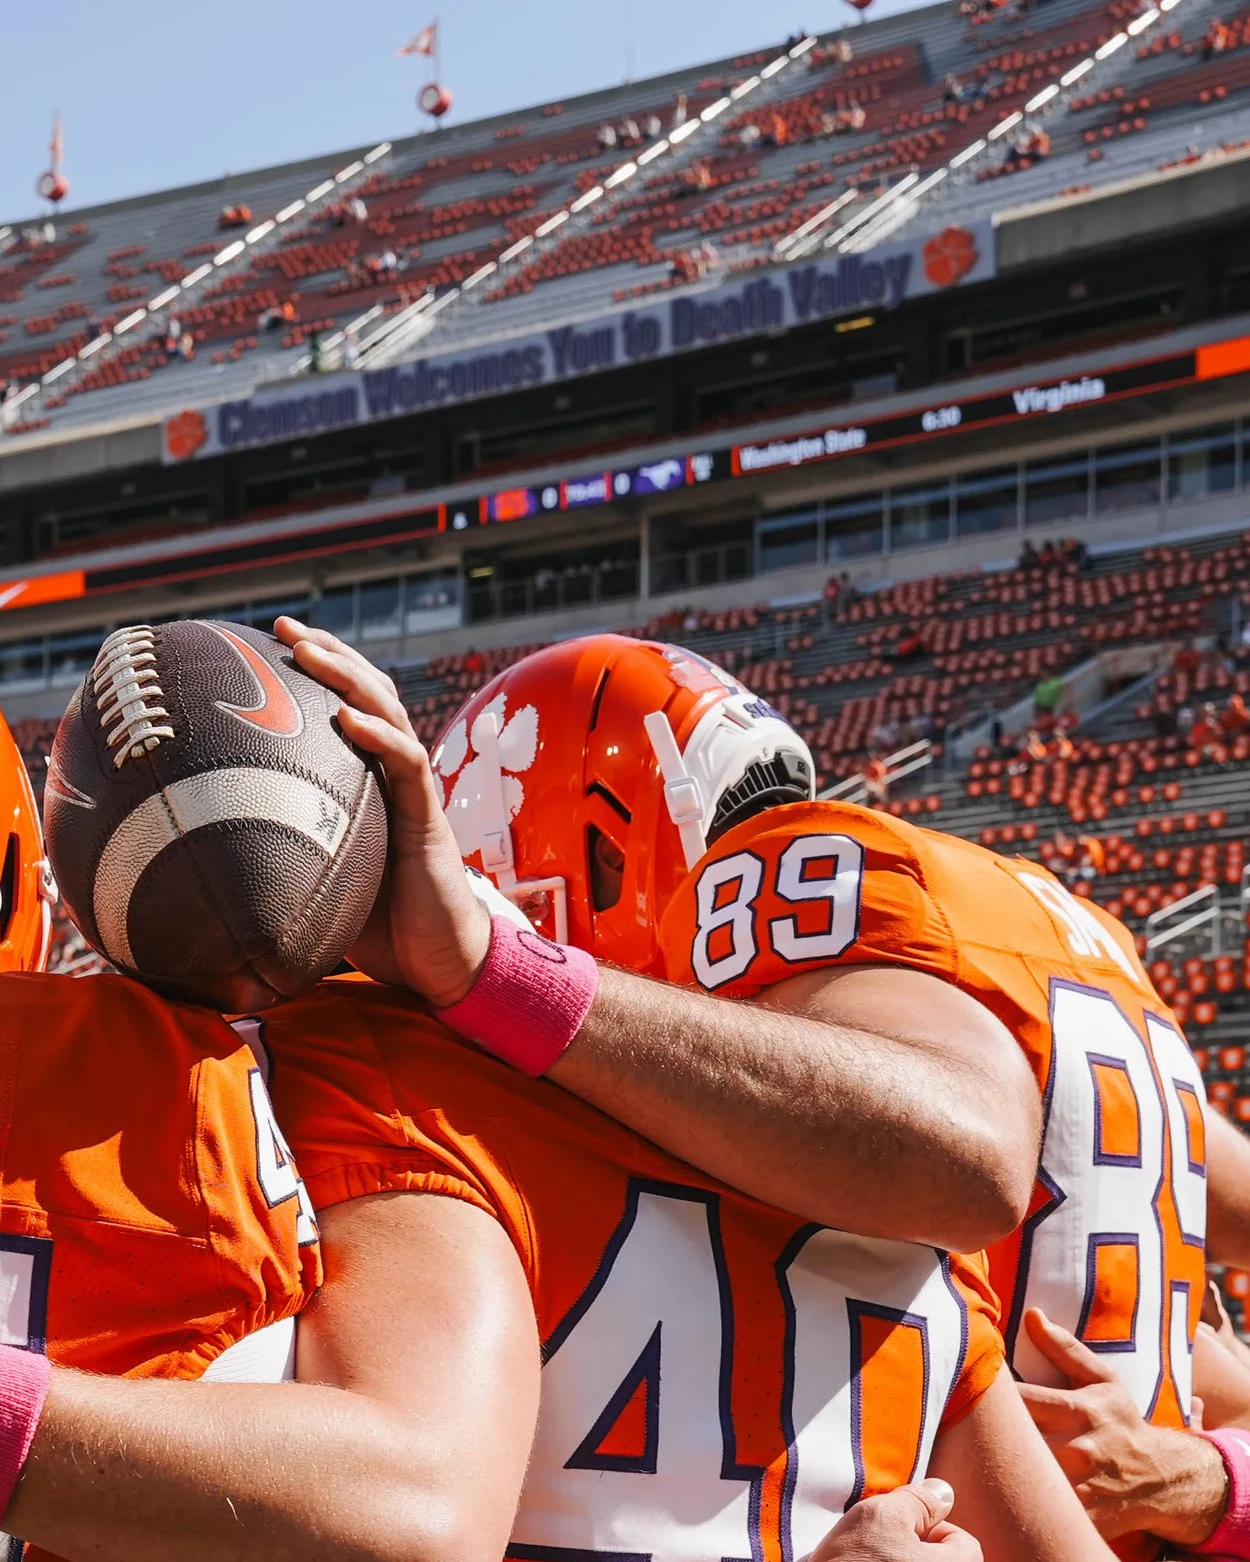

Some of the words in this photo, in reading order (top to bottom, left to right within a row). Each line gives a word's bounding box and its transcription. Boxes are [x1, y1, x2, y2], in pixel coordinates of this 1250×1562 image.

[547, 323, 616, 374] You
[623, 311, 661, 354] to
[788, 252, 914, 318] Valley
[1013, 376, 1105, 415] Virginia
[691, 833, 868, 992] 89
